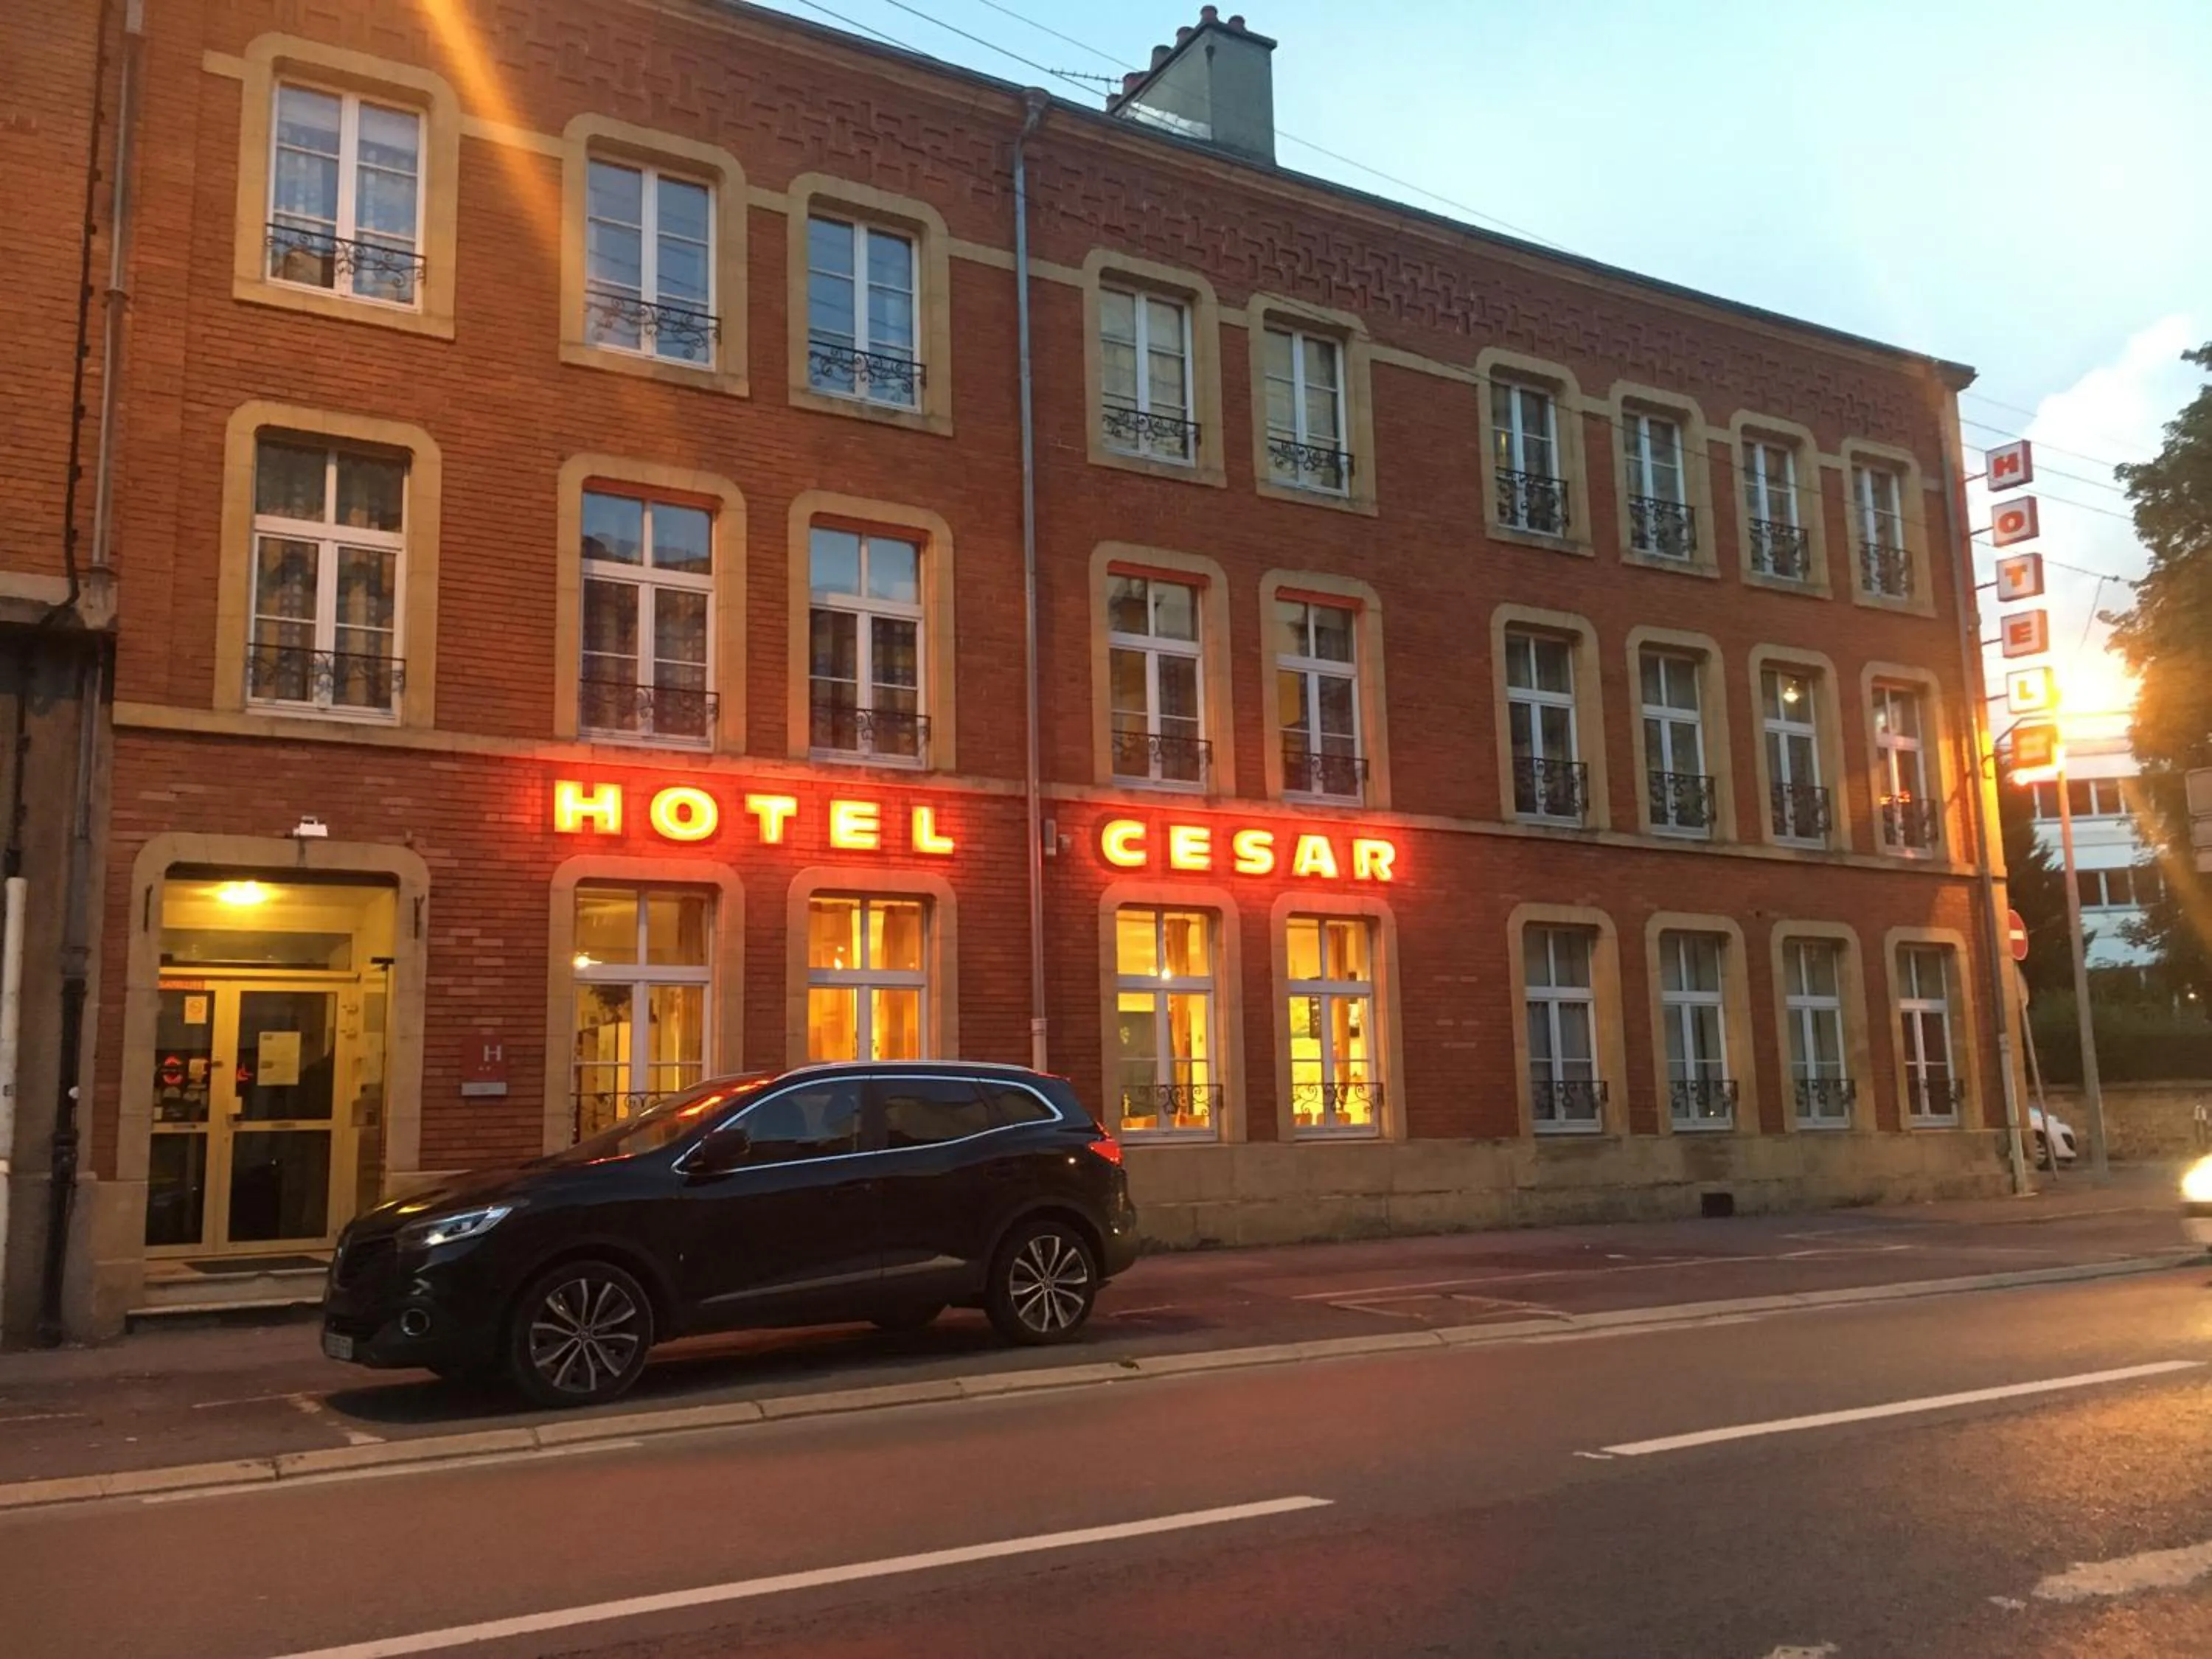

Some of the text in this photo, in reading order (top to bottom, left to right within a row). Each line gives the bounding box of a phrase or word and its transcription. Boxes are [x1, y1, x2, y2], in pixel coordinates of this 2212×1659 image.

[1992, 451, 2034, 701] HOTEL
[554, 780, 1396, 881] HOTEL CESAR
[484, 1045, 501, 1062] H
